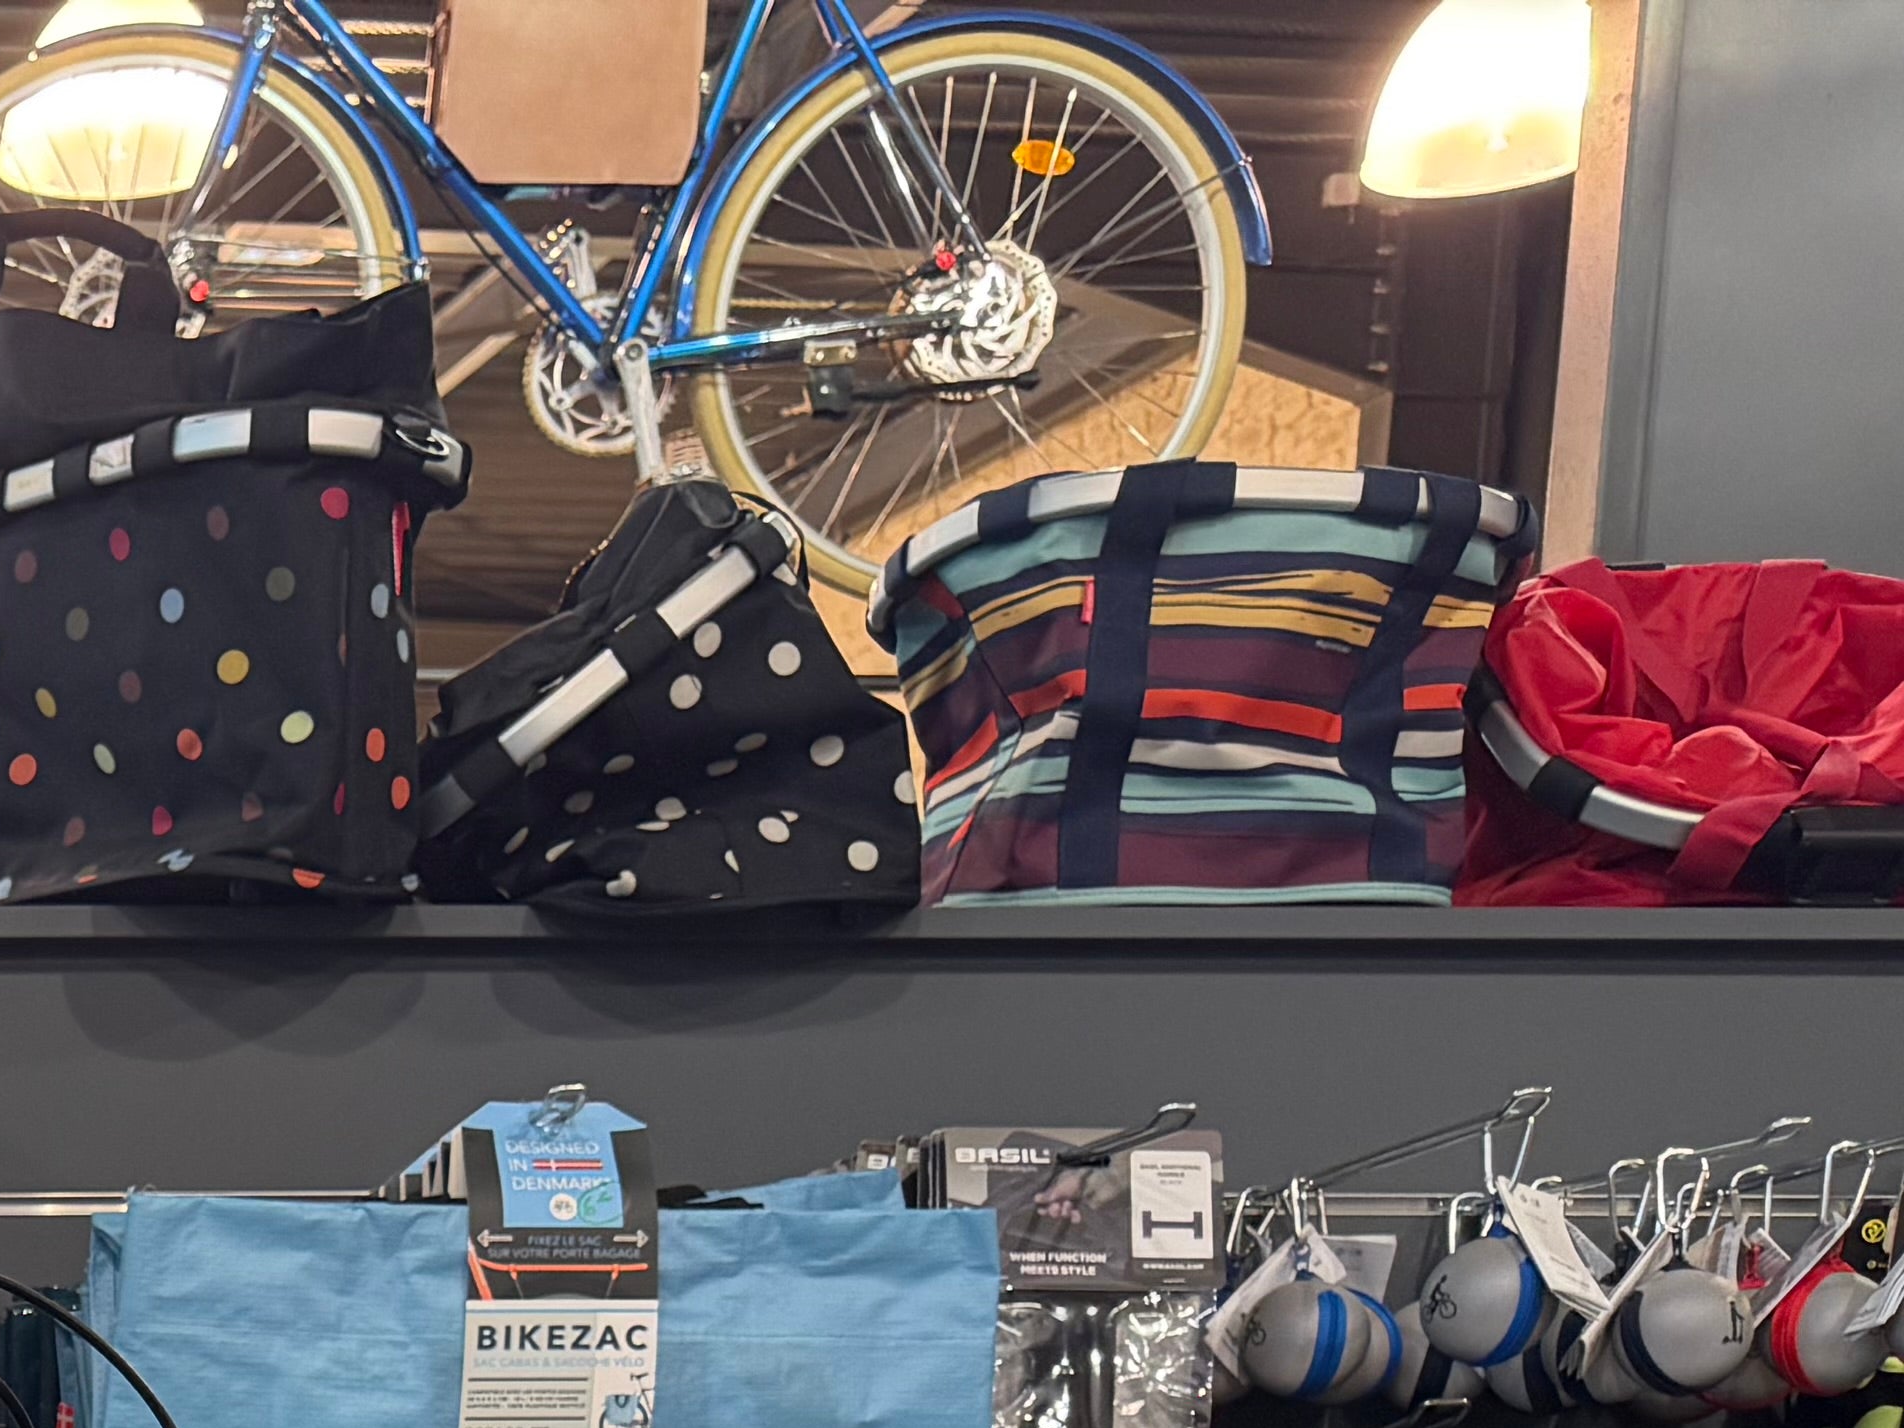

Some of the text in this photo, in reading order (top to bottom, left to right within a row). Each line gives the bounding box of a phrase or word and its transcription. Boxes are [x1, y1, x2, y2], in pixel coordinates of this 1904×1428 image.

[505, 1140, 600, 1155] DESIGNED
[508, 1159, 528, 1171] IN
[1061, 1265, 1097, 1276] STYLE
[477, 1324, 649, 1351] BIKEZAC
